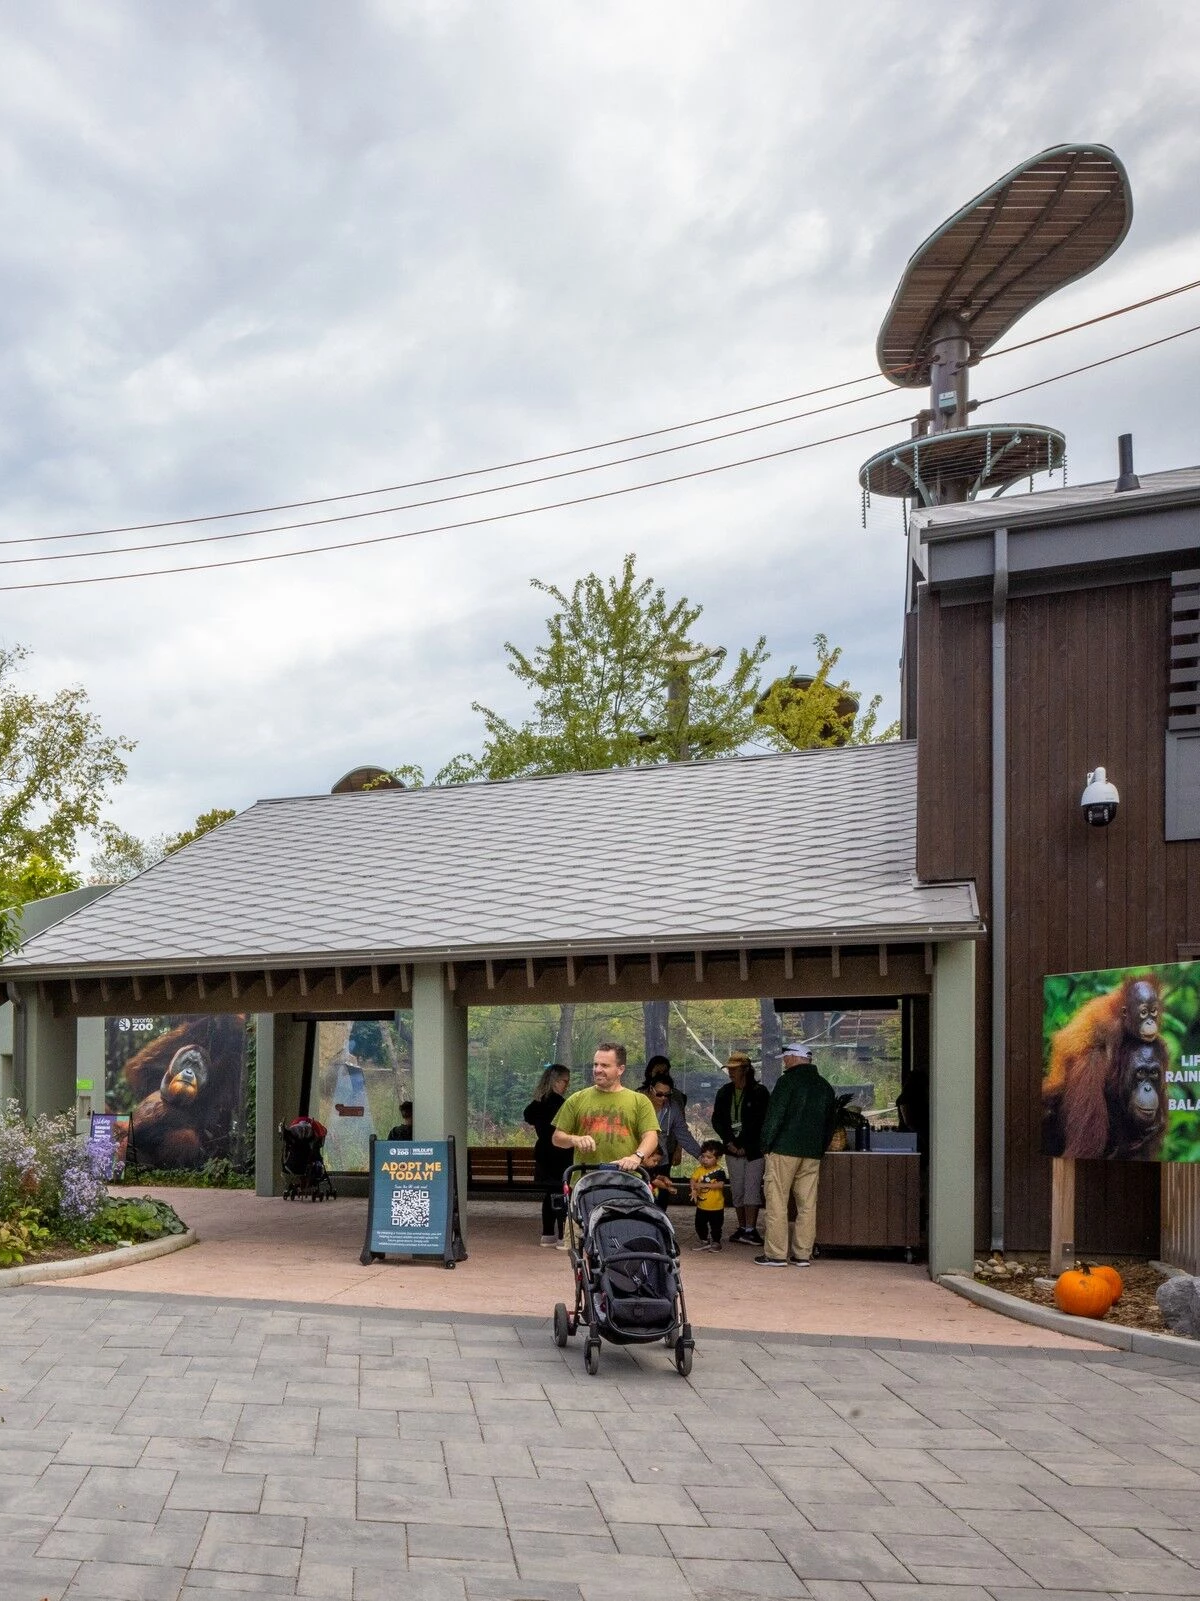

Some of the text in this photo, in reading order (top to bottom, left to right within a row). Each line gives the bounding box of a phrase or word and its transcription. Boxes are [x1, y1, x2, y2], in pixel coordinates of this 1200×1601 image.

[1166, 1070, 1200, 1082] RAIN
[382, 1162, 442, 1172] ADOPT ME
[390, 1172, 433, 1180] TODAY!
